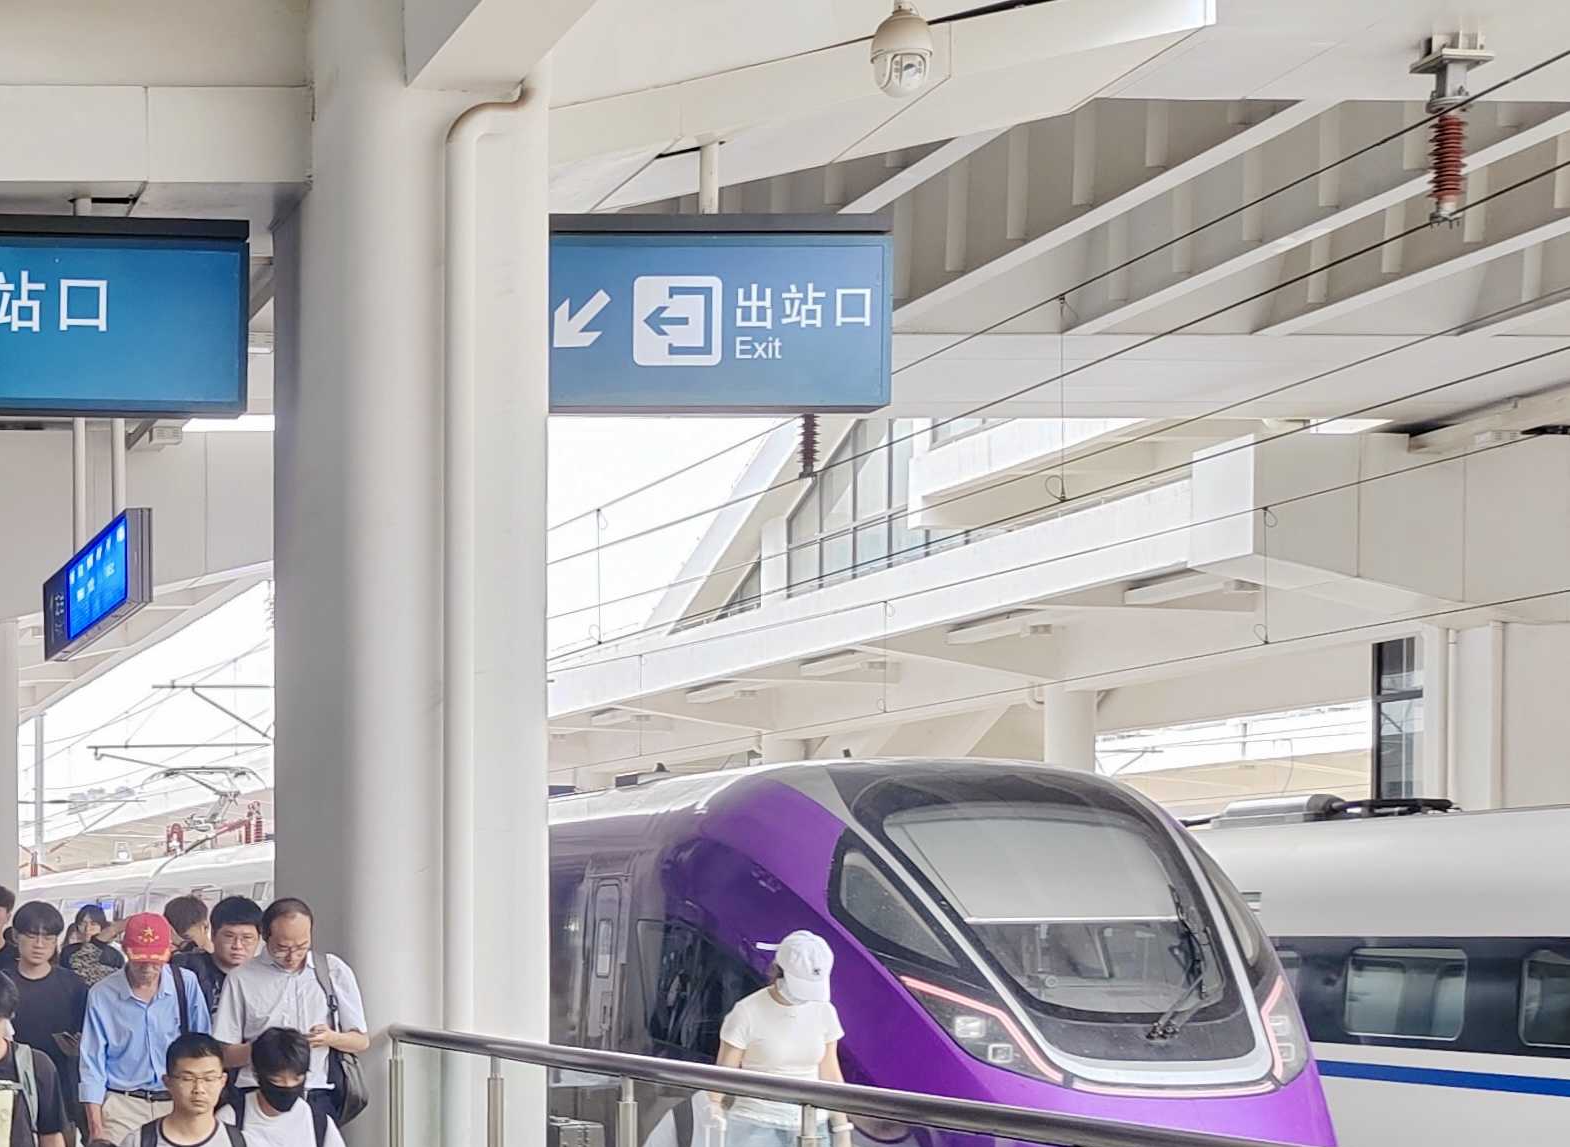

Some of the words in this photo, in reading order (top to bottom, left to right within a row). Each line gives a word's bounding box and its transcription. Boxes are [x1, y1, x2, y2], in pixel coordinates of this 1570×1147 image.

[735, 282, 872, 330] 出站口
[735, 335, 782, 359] Exit
